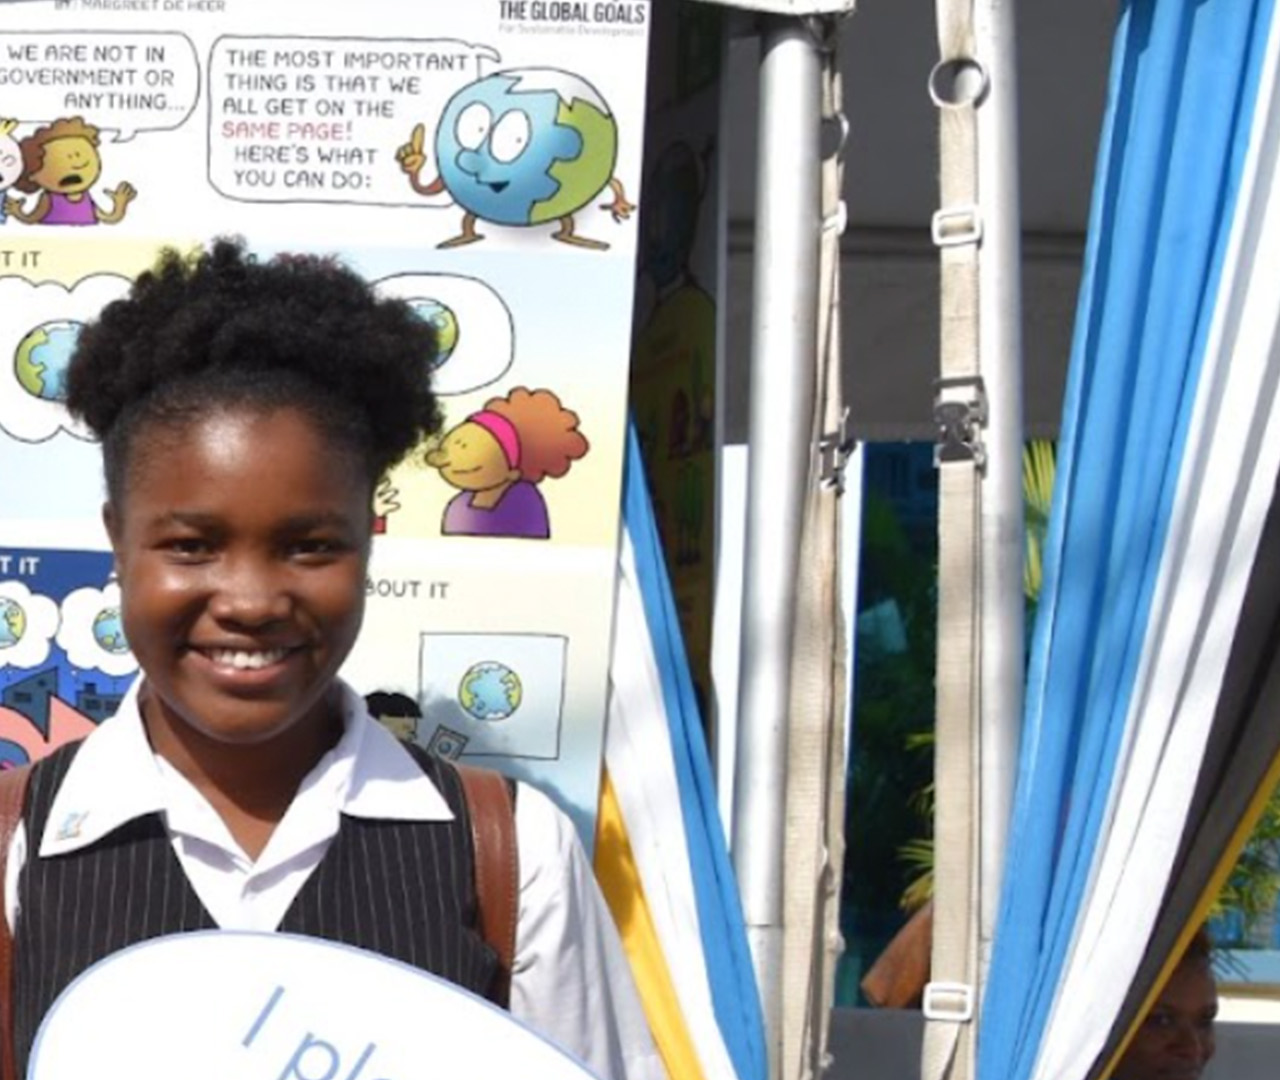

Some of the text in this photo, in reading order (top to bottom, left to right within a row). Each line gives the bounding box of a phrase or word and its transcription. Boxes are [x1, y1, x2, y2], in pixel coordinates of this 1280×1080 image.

[500, 0, 645, 24] THE GLOBAL GOALS
[7, 45, 165, 63] WE ARE NOT IN
[225, 50, 469, 71] THE MOST IMPORTANT
[144, 69, 175, 87] OR
[224, 73, 421, 95] THING IS THAT WE
[63, 92, 186, 111] ANYTHING...
[222, 97, 395, 118] ALL GET ON THE
[221, 121, 354, 141] SAME PAGE!
[234, 143, 379, 165] HERE'S WHAT
[234, 169, 373, 189] YOU CAN DO:
[21, 250, 41, 268] IT
[19, 556, 39, 574] IT
[366, 579, 449, 598] BOUT IT
[242, 986, 285, 1048] I
